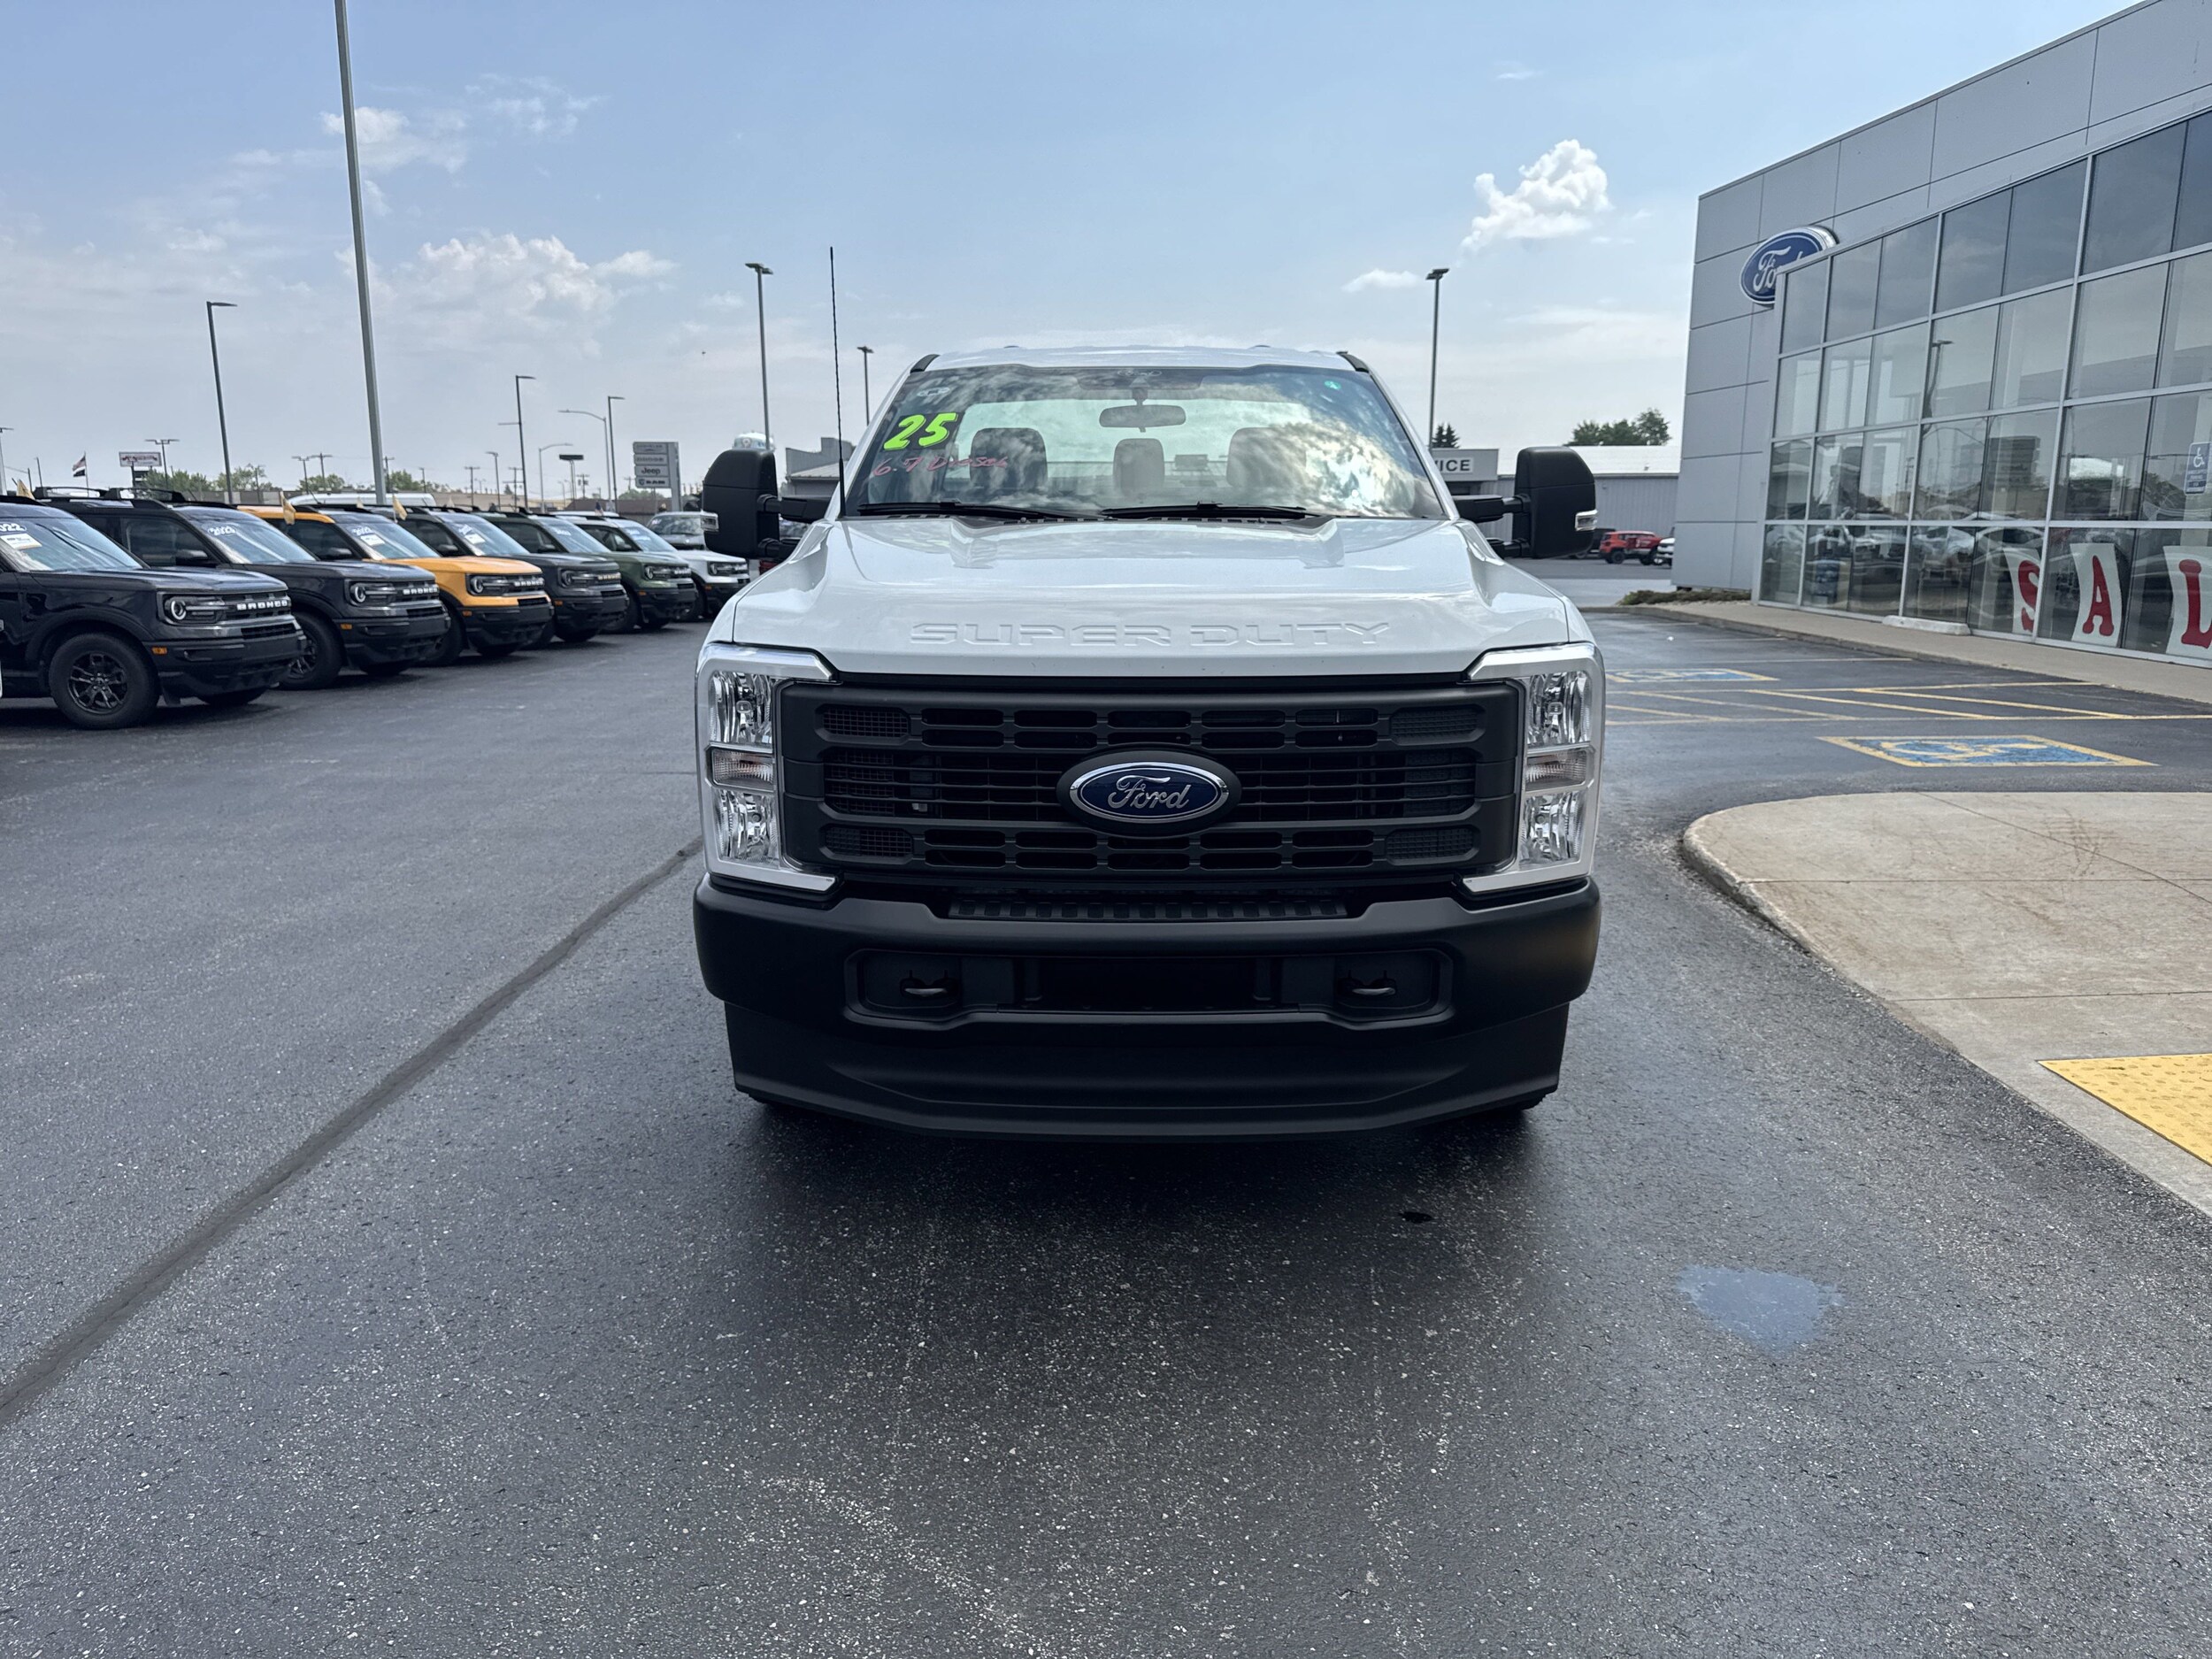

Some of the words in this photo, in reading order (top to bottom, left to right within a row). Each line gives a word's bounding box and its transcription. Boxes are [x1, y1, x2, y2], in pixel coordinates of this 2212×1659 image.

[883, 412, 958, 450] 25
[1435, 459, 1471, 472] ICE
[910, 623, 1171, 646] SUPER
[1190, 623, 1390, 645] DUTY
[1108, 775, 1192, 809] Ford
